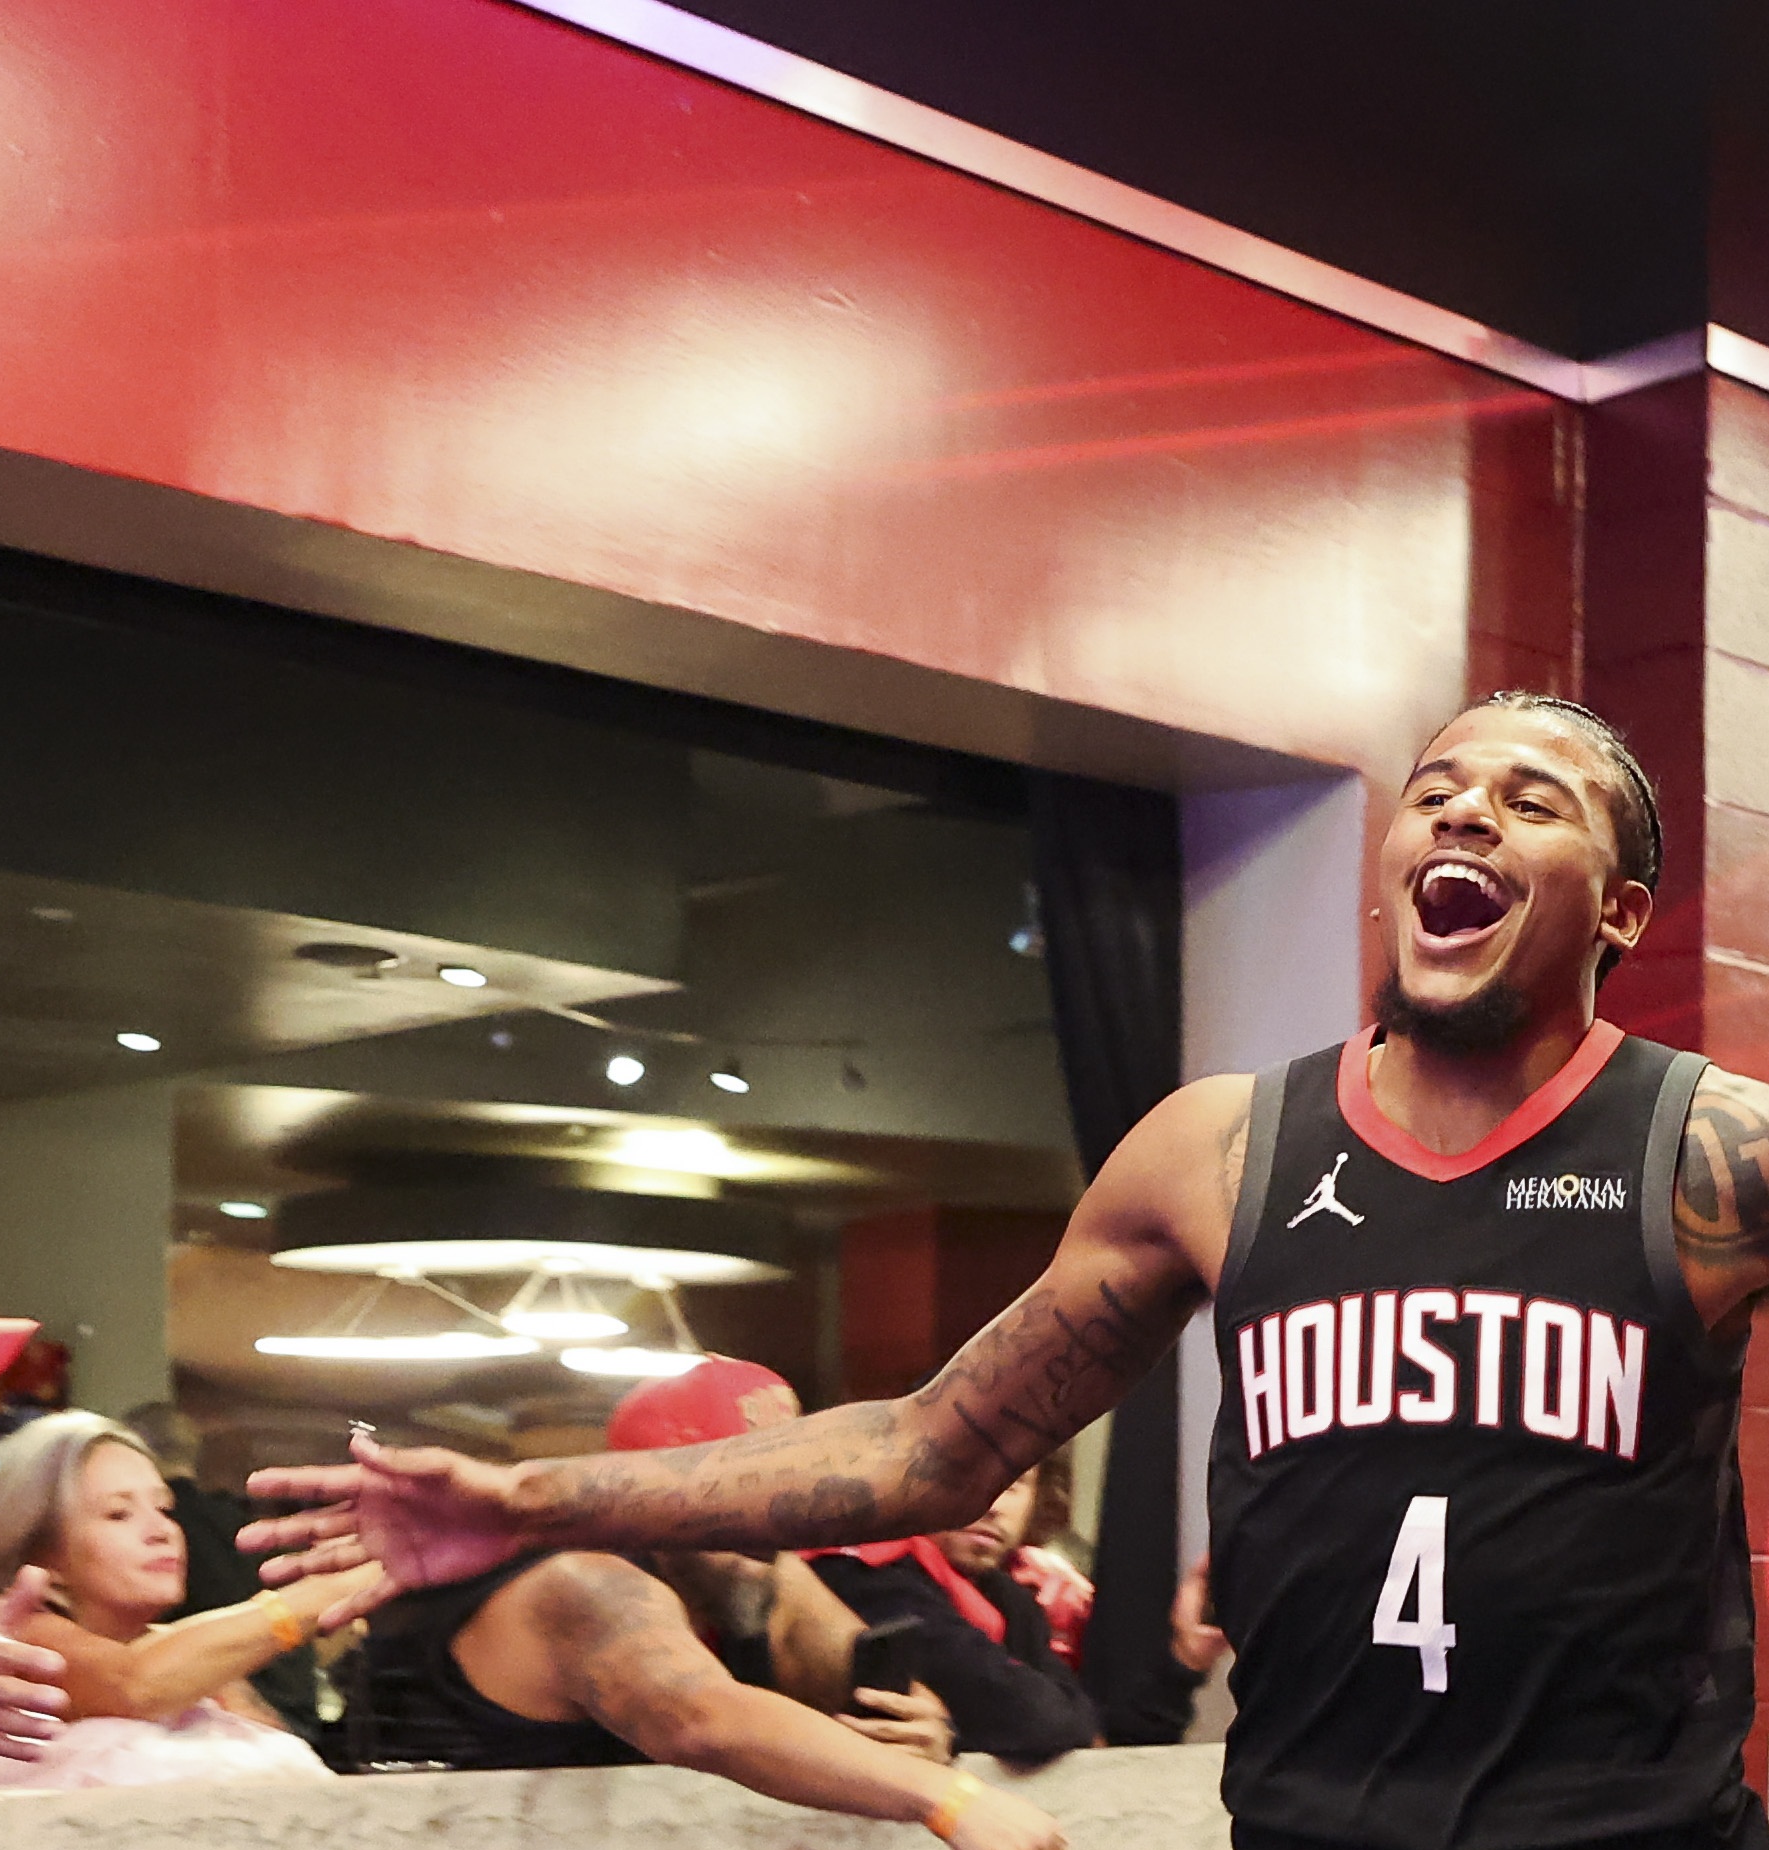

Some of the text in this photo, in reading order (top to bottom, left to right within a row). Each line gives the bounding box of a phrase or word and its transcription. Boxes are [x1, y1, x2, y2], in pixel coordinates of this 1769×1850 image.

[1505, 1191, 1627, 1210] HERMANN
[1507, 1172, 1627, 1196] MEMORIAL
[1236, 1289, 1649, 1462] HOUSTON
[1372, 1495, 1457, 1694] 4
